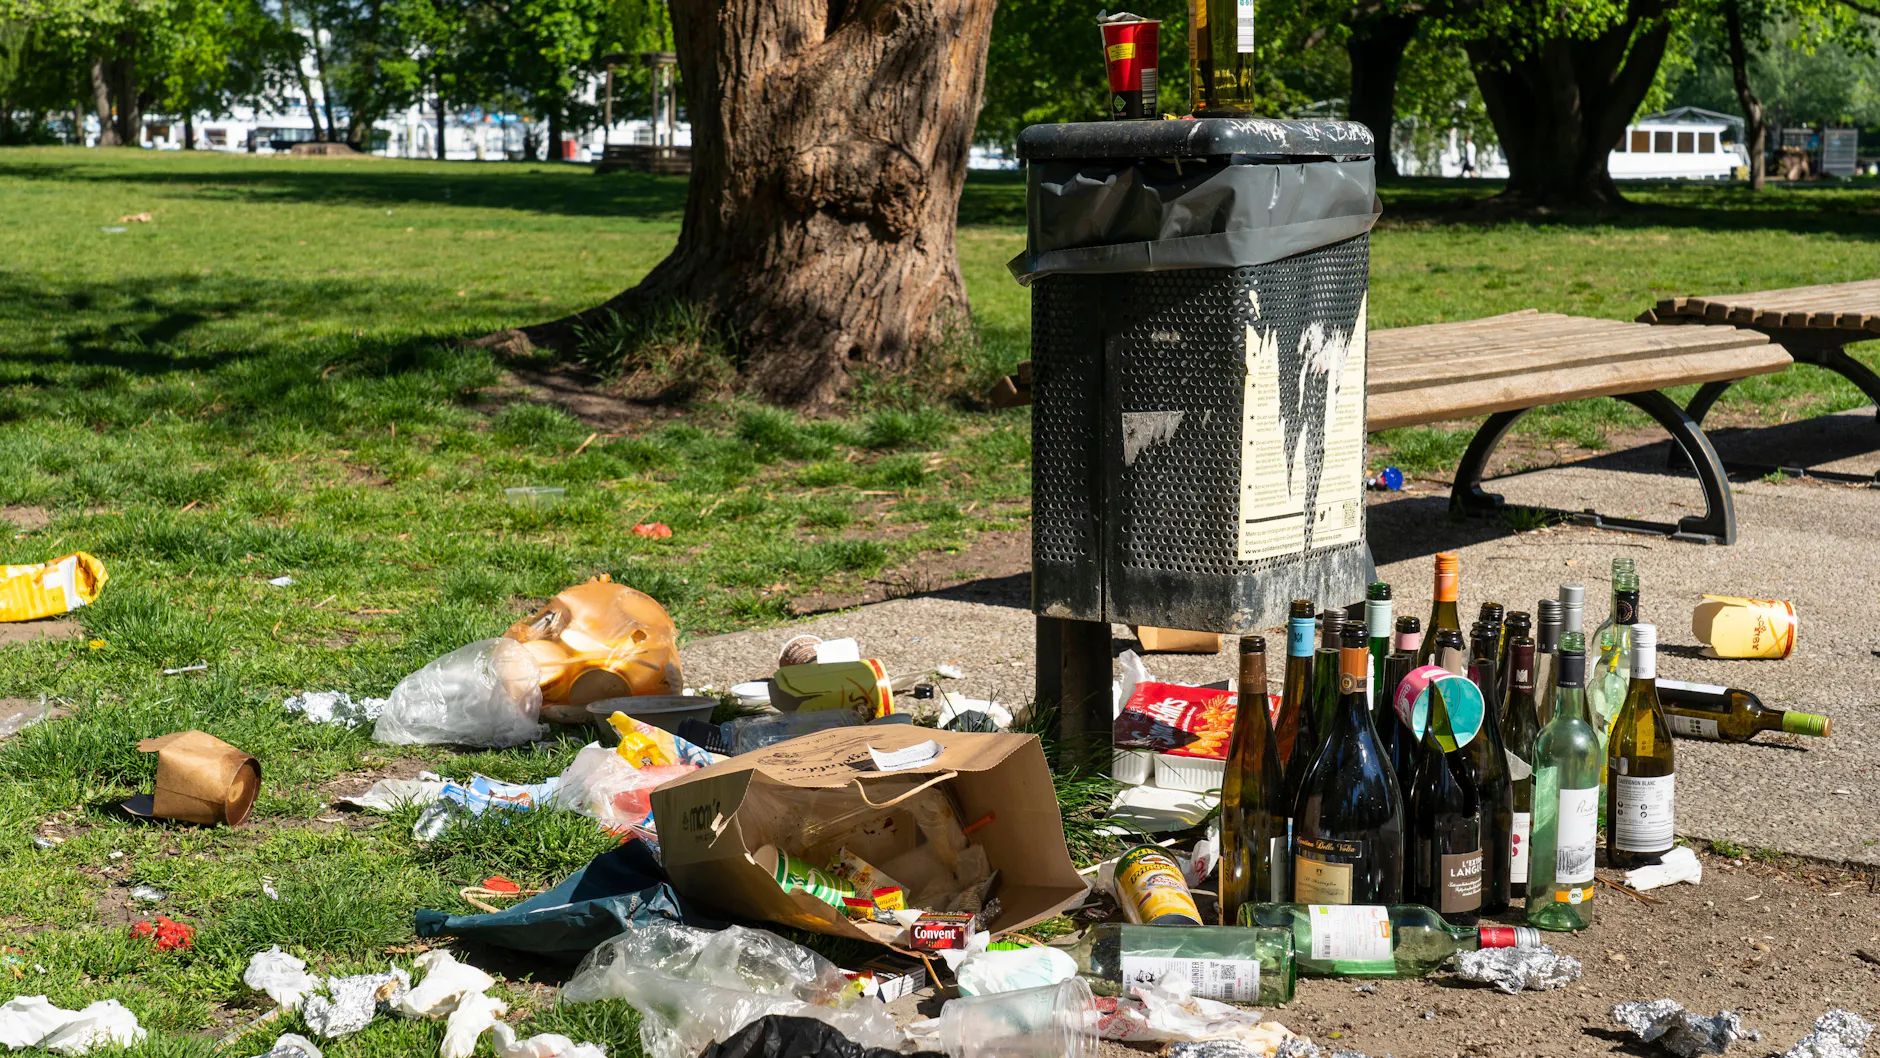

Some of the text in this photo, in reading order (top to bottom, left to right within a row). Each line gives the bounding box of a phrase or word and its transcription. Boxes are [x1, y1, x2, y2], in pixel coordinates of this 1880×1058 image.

[1316, 840, 1335, 851] Della
[1336, 843, 1356, 853] Volta
[876, 896, 897, 906] Fortun
[914, 926, 956, 940] Convent
